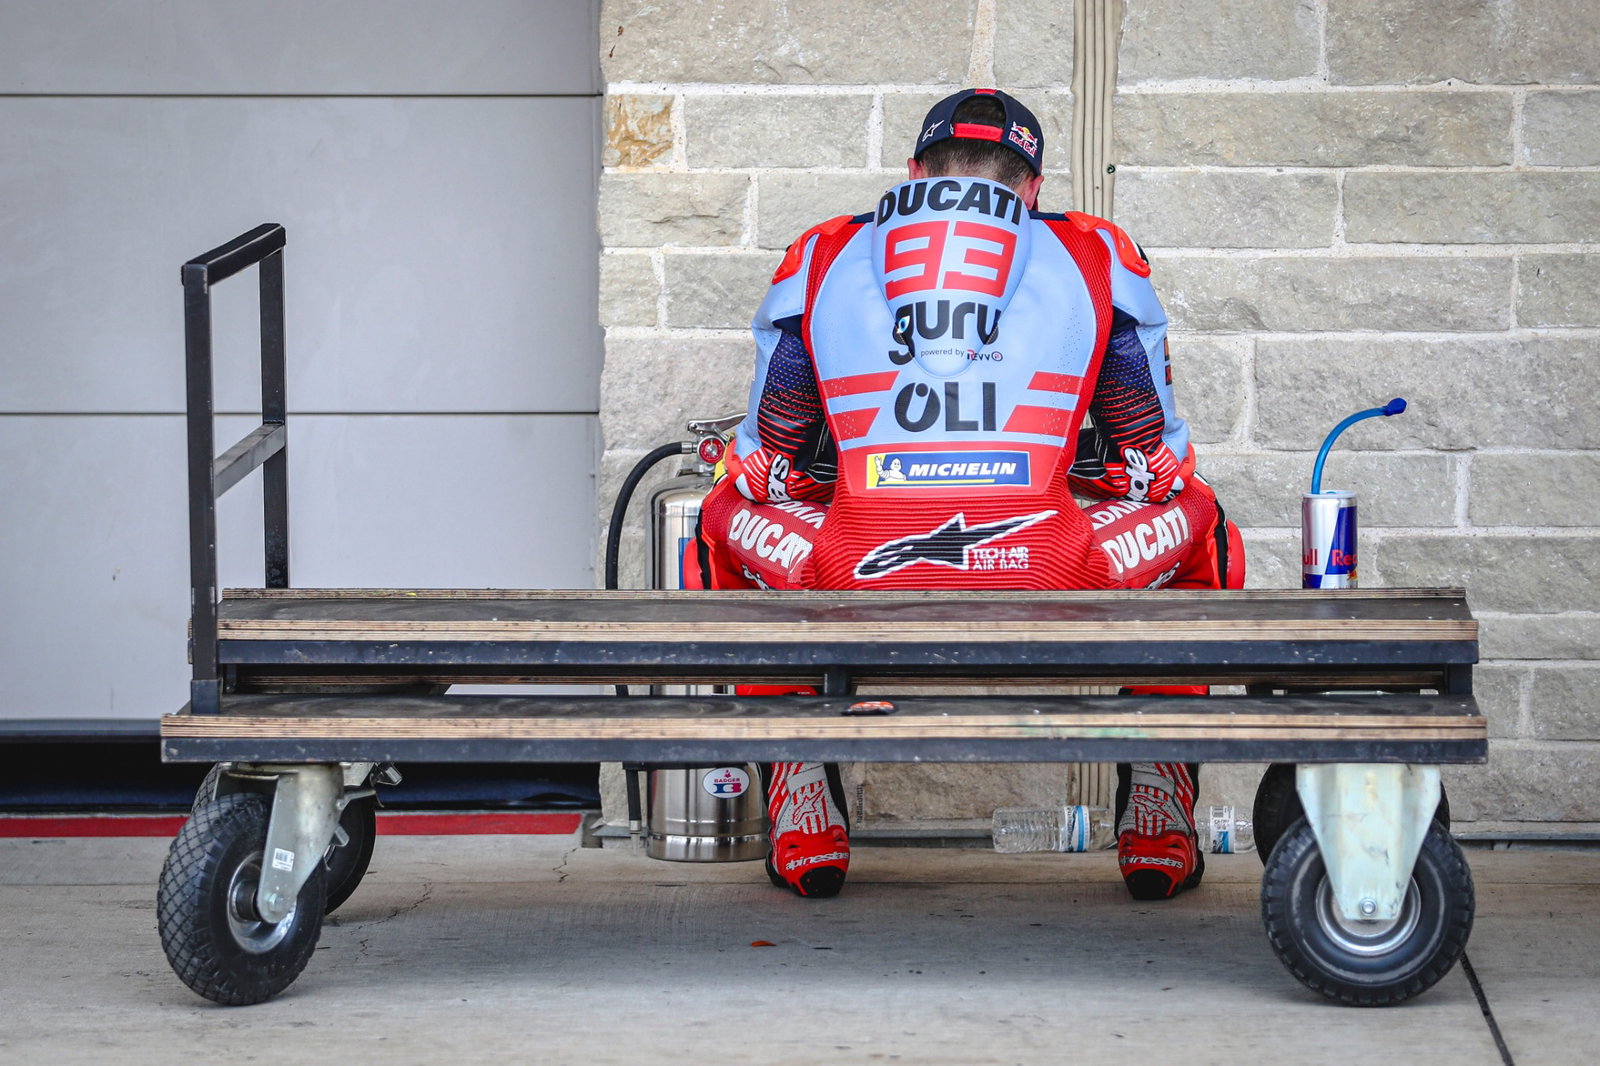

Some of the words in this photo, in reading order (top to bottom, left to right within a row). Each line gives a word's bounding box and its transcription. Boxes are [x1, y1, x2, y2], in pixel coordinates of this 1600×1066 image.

[1008, 131, 1025, 148] Red
[877, 179, 1022, 227] DUCATI
[920, 348, 953, 358] powered
[955, 348, 965, 358] by
[908, 462, 1017, 476] MICHELIN
[1101, 506, 1189, 574] DUCATI
[972, 559, 995, 570] AIR
[999, 558, 1029, 570] BAG
[1303, 548, 1318, 566] ull
